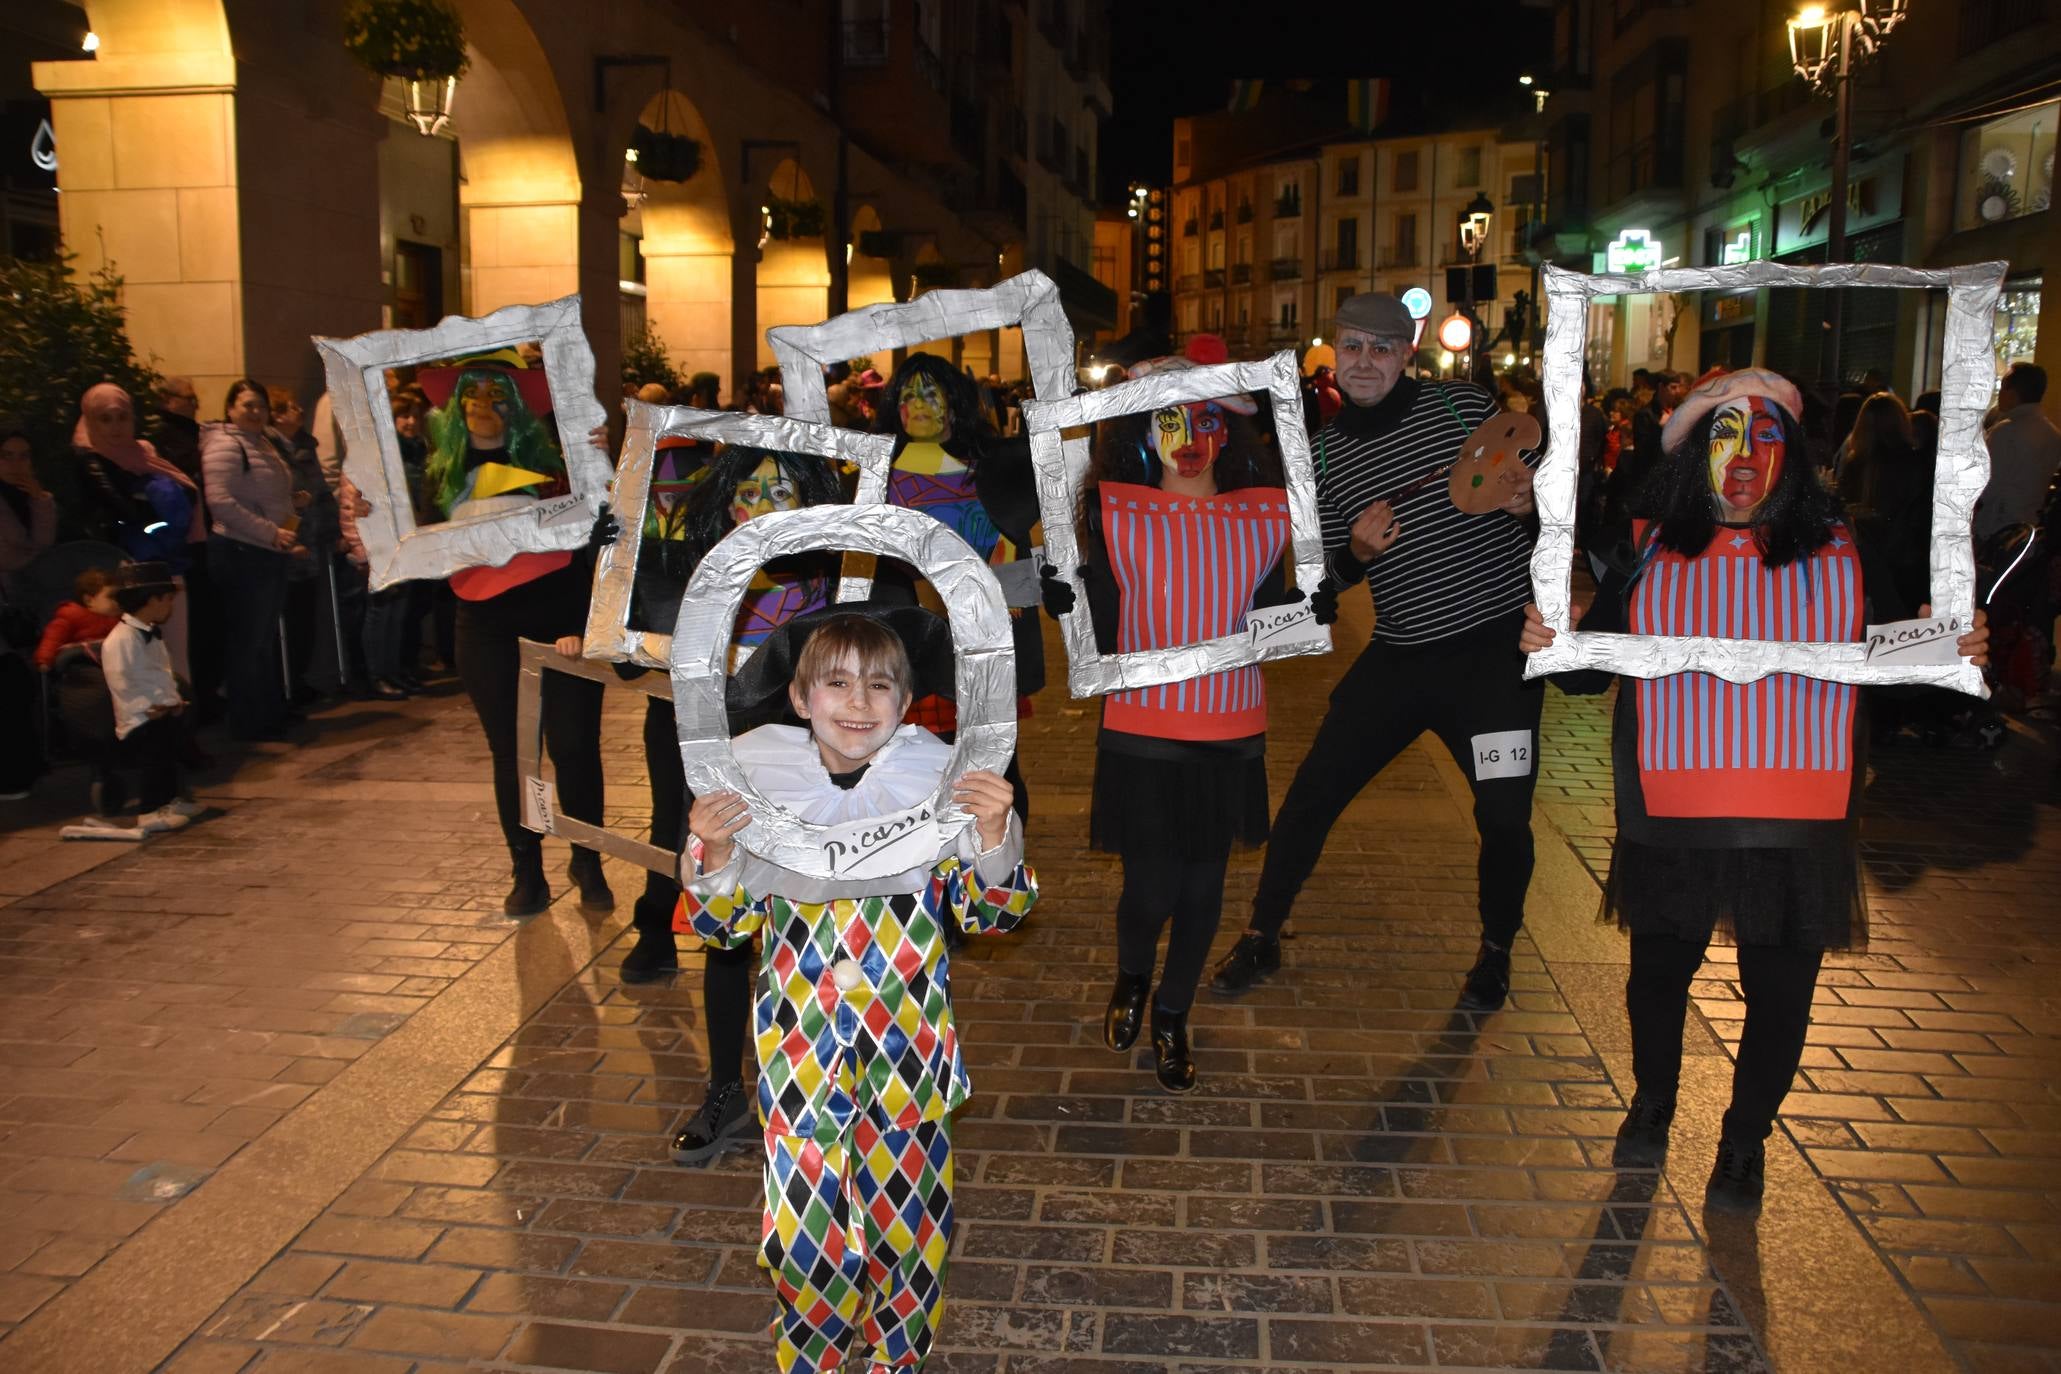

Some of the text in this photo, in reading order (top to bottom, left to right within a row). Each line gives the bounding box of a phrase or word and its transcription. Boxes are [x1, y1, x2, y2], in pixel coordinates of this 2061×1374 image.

[1250, 605, 1311, 648] Picass
[1866, 618, 1958, 662] Picasso
[1480, 748, 1527, 764] I-G 12
[824, 808, 932, 872] Picasso
